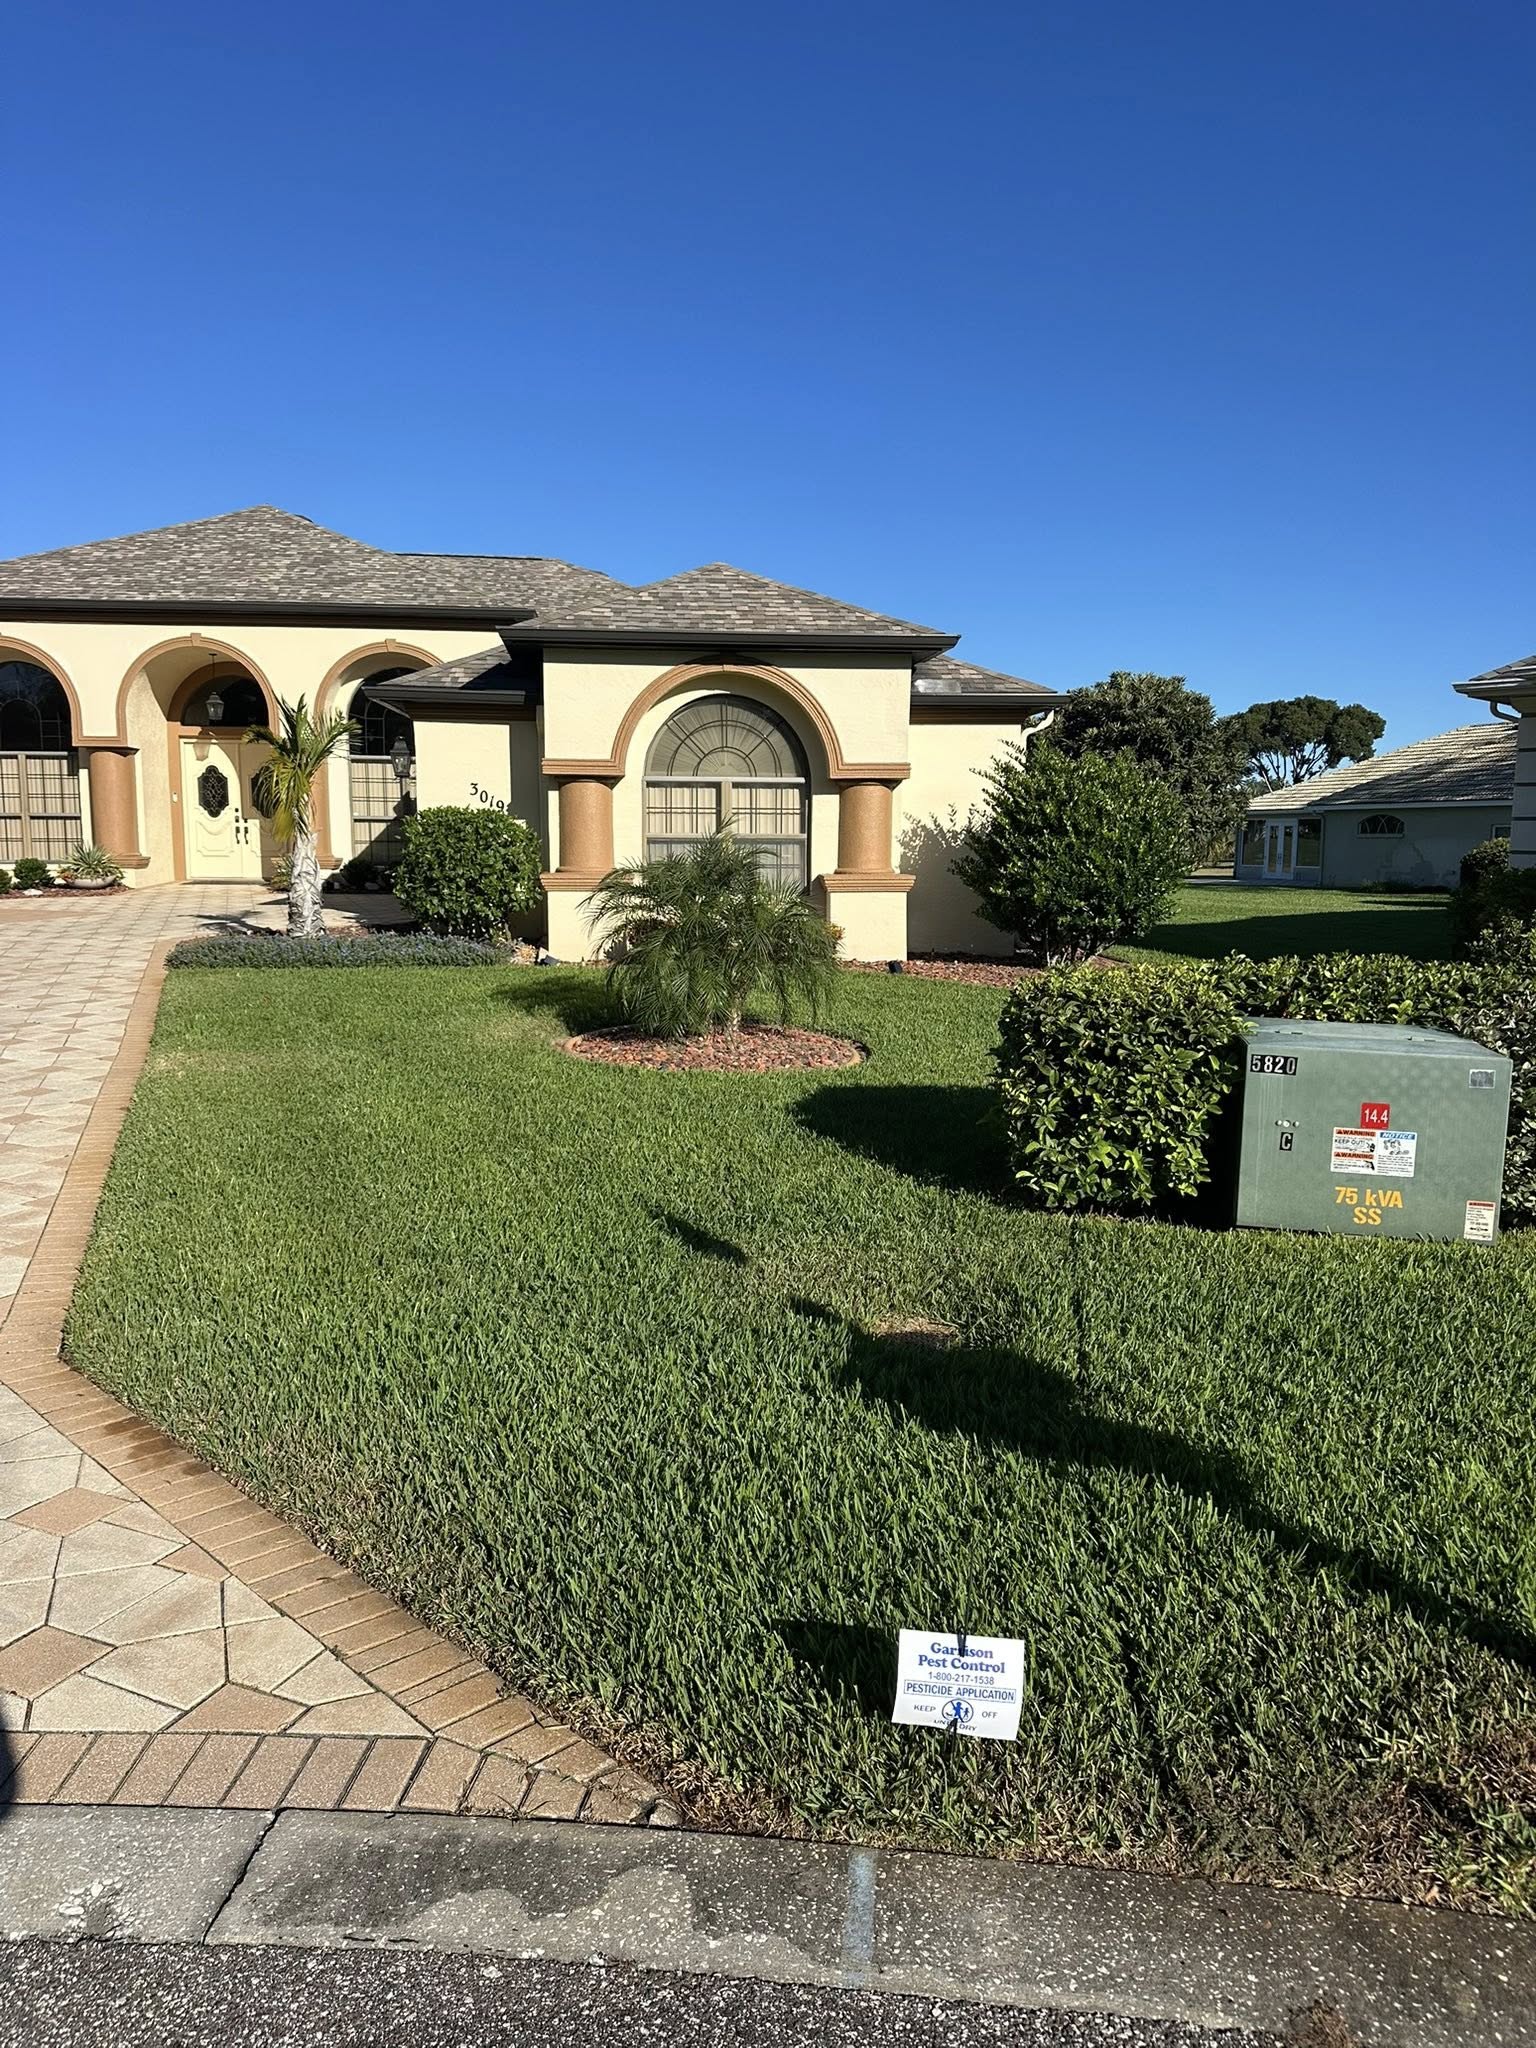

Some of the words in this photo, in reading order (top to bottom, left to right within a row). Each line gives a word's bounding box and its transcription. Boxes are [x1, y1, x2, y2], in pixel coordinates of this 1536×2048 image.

[469, 782, 505, 812] 3019
[1251, 1055, 1297, 1074] 5820
[1364, 1108, 1388, 1123] 14.4
[1281, 1133, 1292, 1150] C
[1342, 1129, 1375, 1137] WARNING
[1382, 1132, 1412, 1140] NOTICE
[1334, 1187, 1358, 1204] 75
[1365, 1189, 1404, 1208] kVA
[1353, 1207, 1382, 1225] SS
[930, 1642, 994, 1659] Garison
[918, 1654, 948, 1668] Pest
[951, 1658, 1006, 1673] Control
[928, 1671, 995, 1685] 1-800-217-1538
[906, 1682, 953, 1696] PESTICIDE
[955, 1687, 1015, 1701] APPLICATION
[913, 1704, 936, 1712] KEEP
[981, 1711, 998, 1719] OFF
